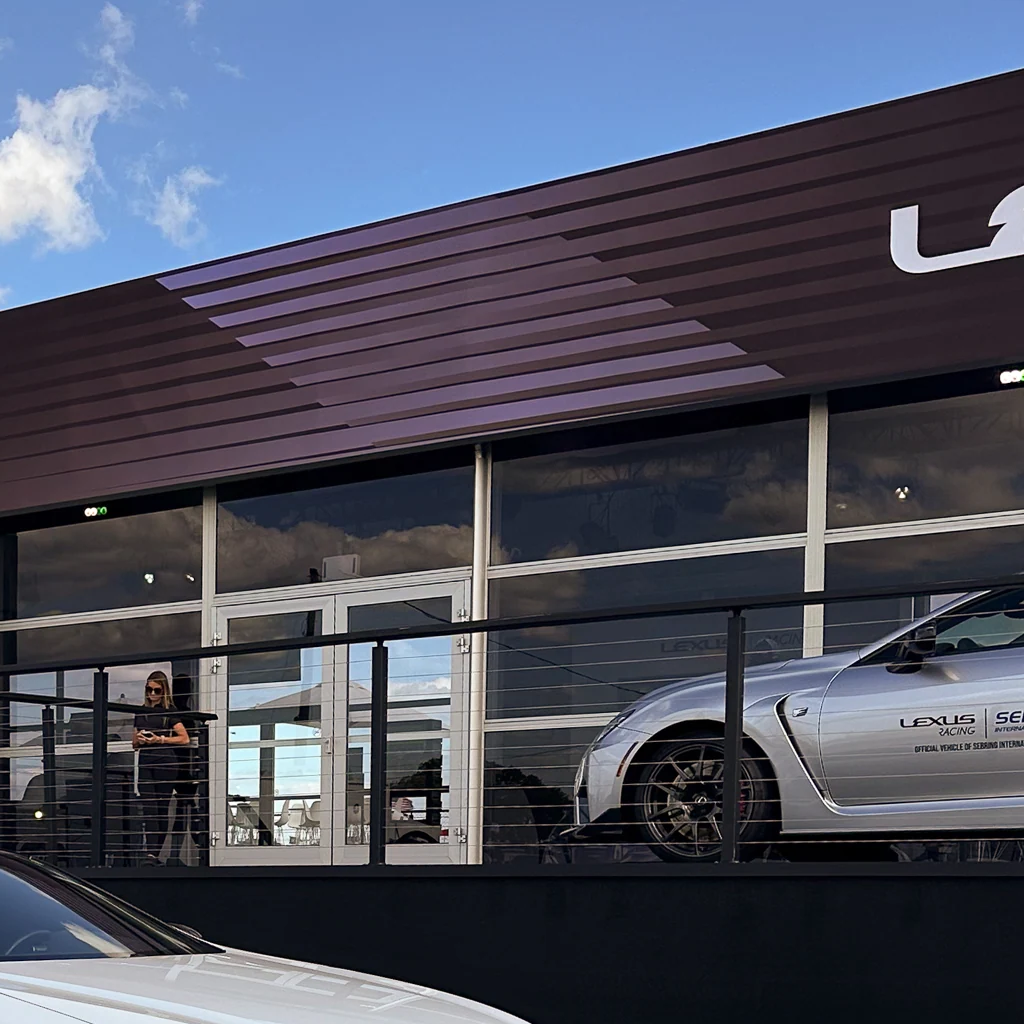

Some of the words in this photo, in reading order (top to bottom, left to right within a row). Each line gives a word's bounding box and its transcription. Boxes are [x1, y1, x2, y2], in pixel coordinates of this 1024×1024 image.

[900, 714, 976, 728] LEXUS
[995, 711, 1024, 724] SE
[939, 727, 976, 736] RACING
[914, 745, 939, 753] OFFICIAL
[940, 743, 964, 751] VEHICLE
[964, 742, 972, 750] OF
[972, 741, 998, 750] SEBRING
